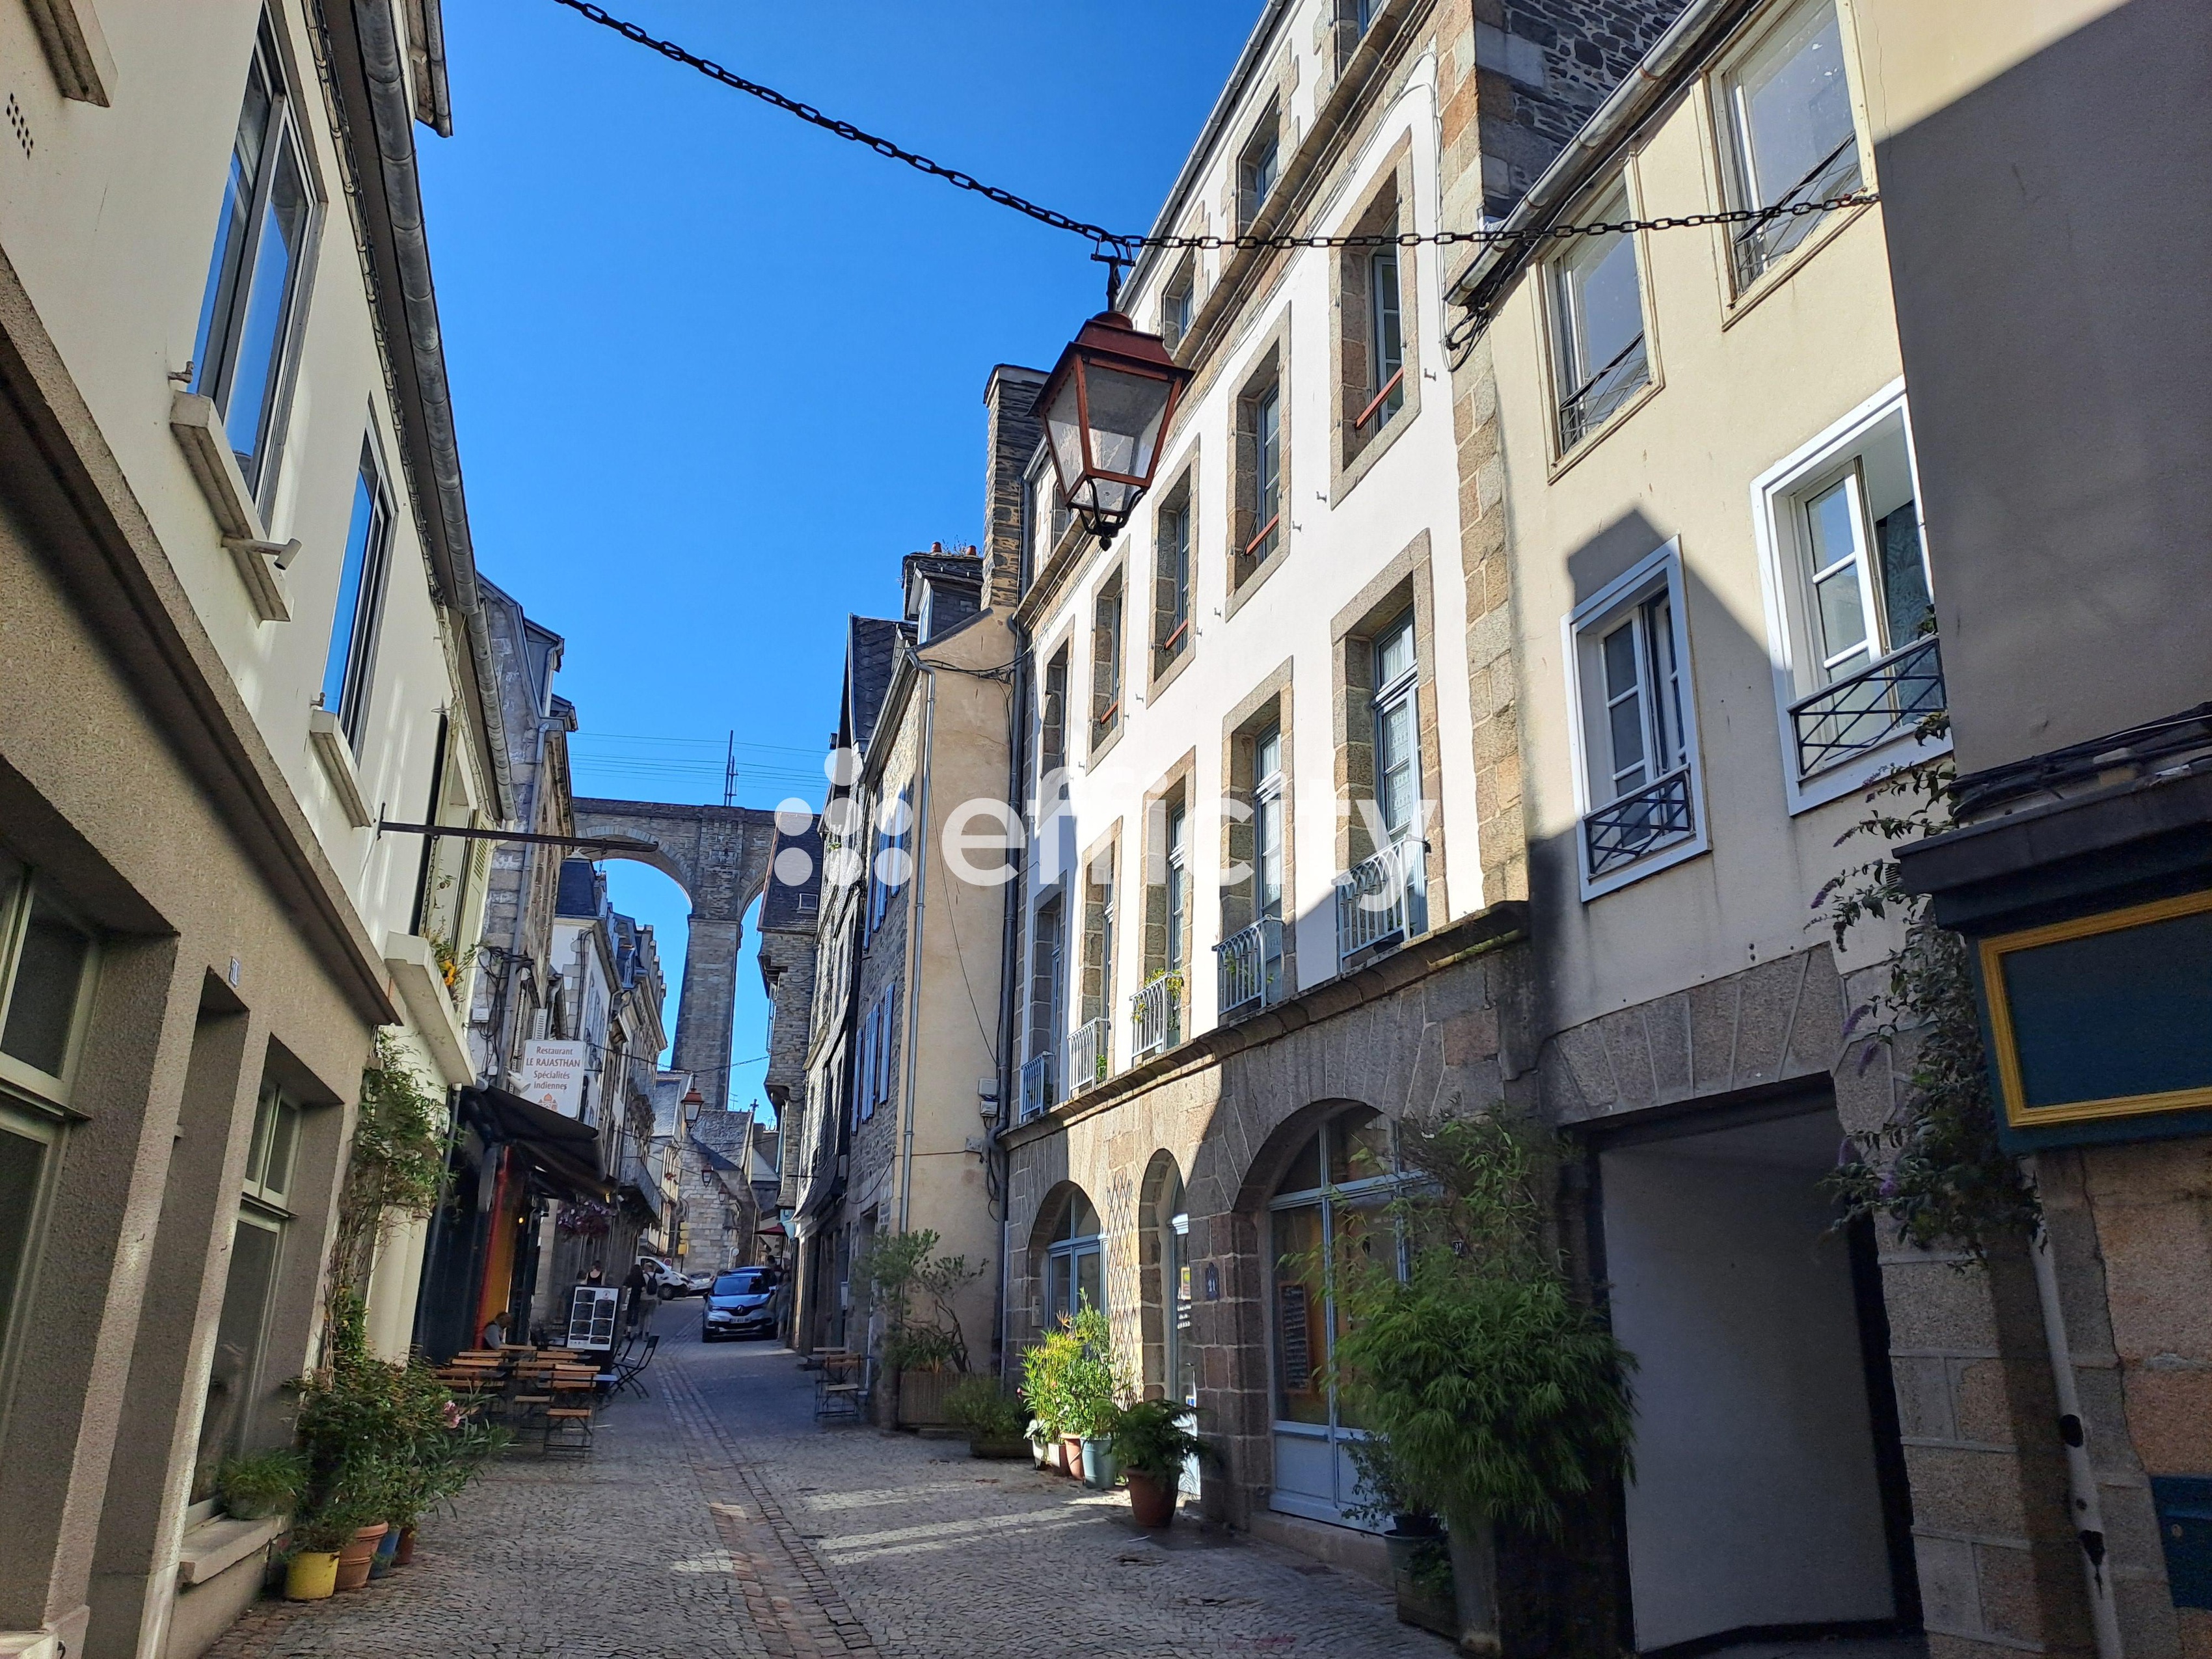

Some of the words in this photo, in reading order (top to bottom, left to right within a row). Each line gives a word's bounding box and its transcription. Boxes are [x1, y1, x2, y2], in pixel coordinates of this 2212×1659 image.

[537, 1046, 573, 1055] Restaurant
[536, 1059, 580, 1067] RAJASTHAN
[533, 1070, 570, 1079] Spécialités
